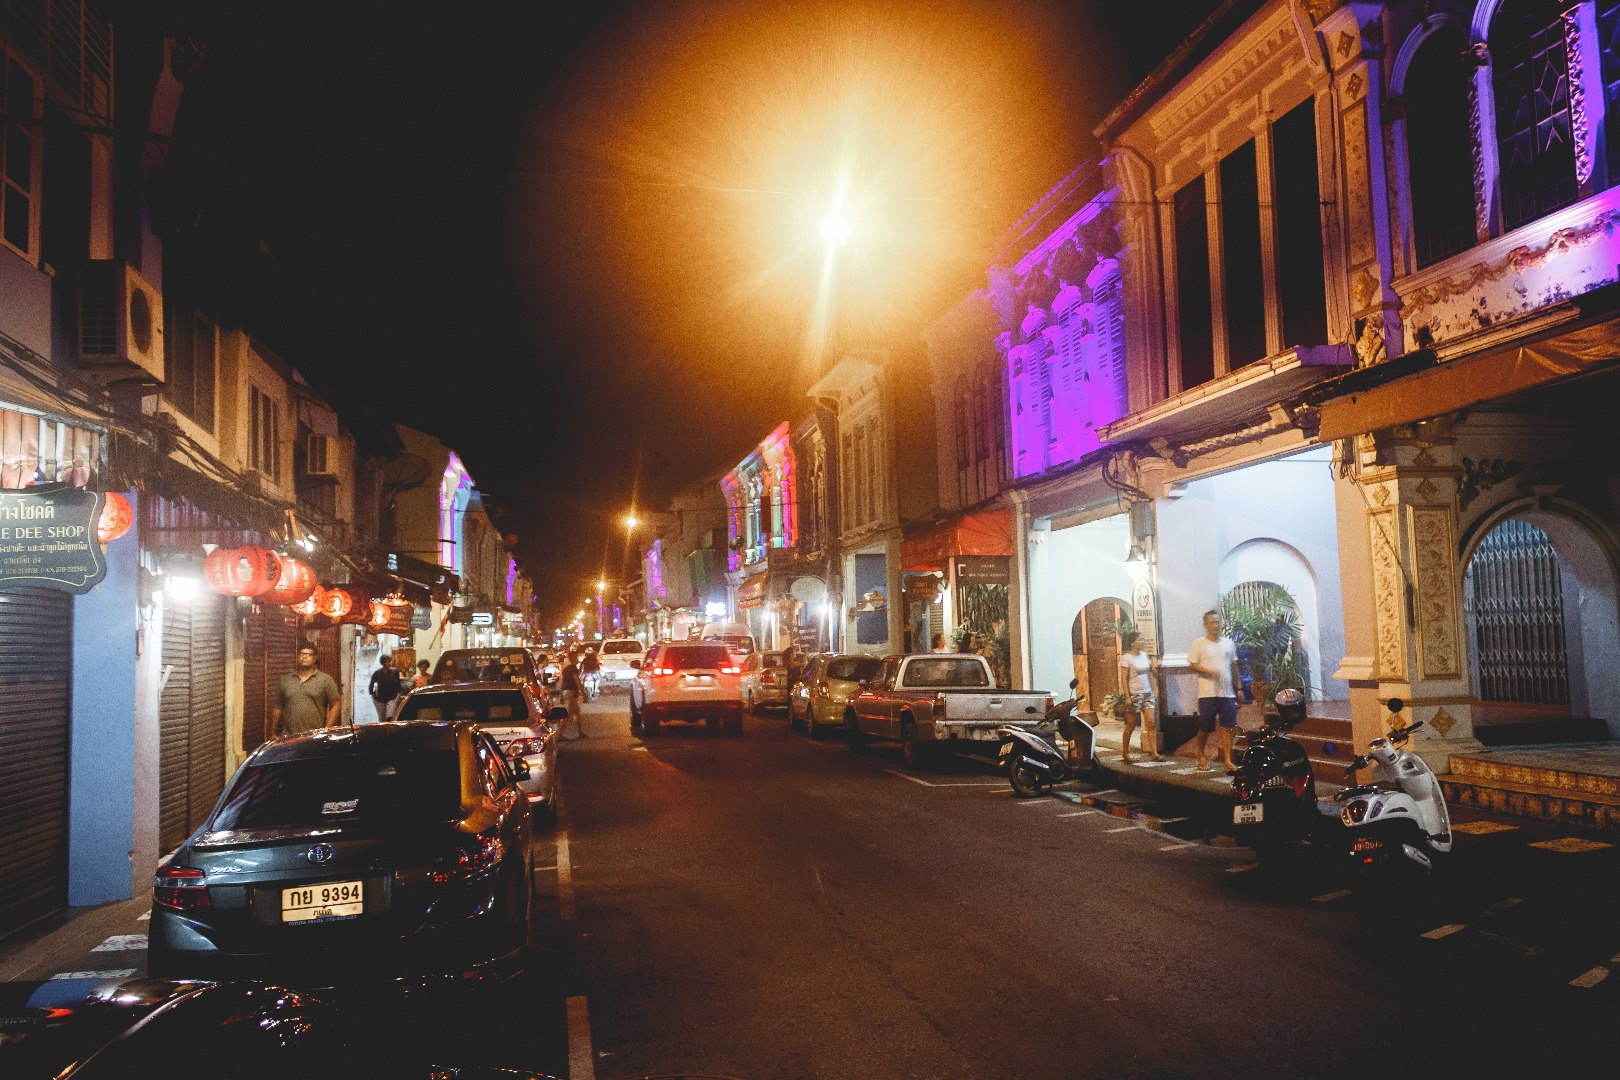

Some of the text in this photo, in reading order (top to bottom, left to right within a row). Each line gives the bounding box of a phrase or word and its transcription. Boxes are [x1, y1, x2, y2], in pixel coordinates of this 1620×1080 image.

[0, 498, 54, 520] างโชคดี
[15, 526, 43, 539] DEE
[47, 526, 84, 538] SHOP
[290, 884, 360, 907] กย 9394
